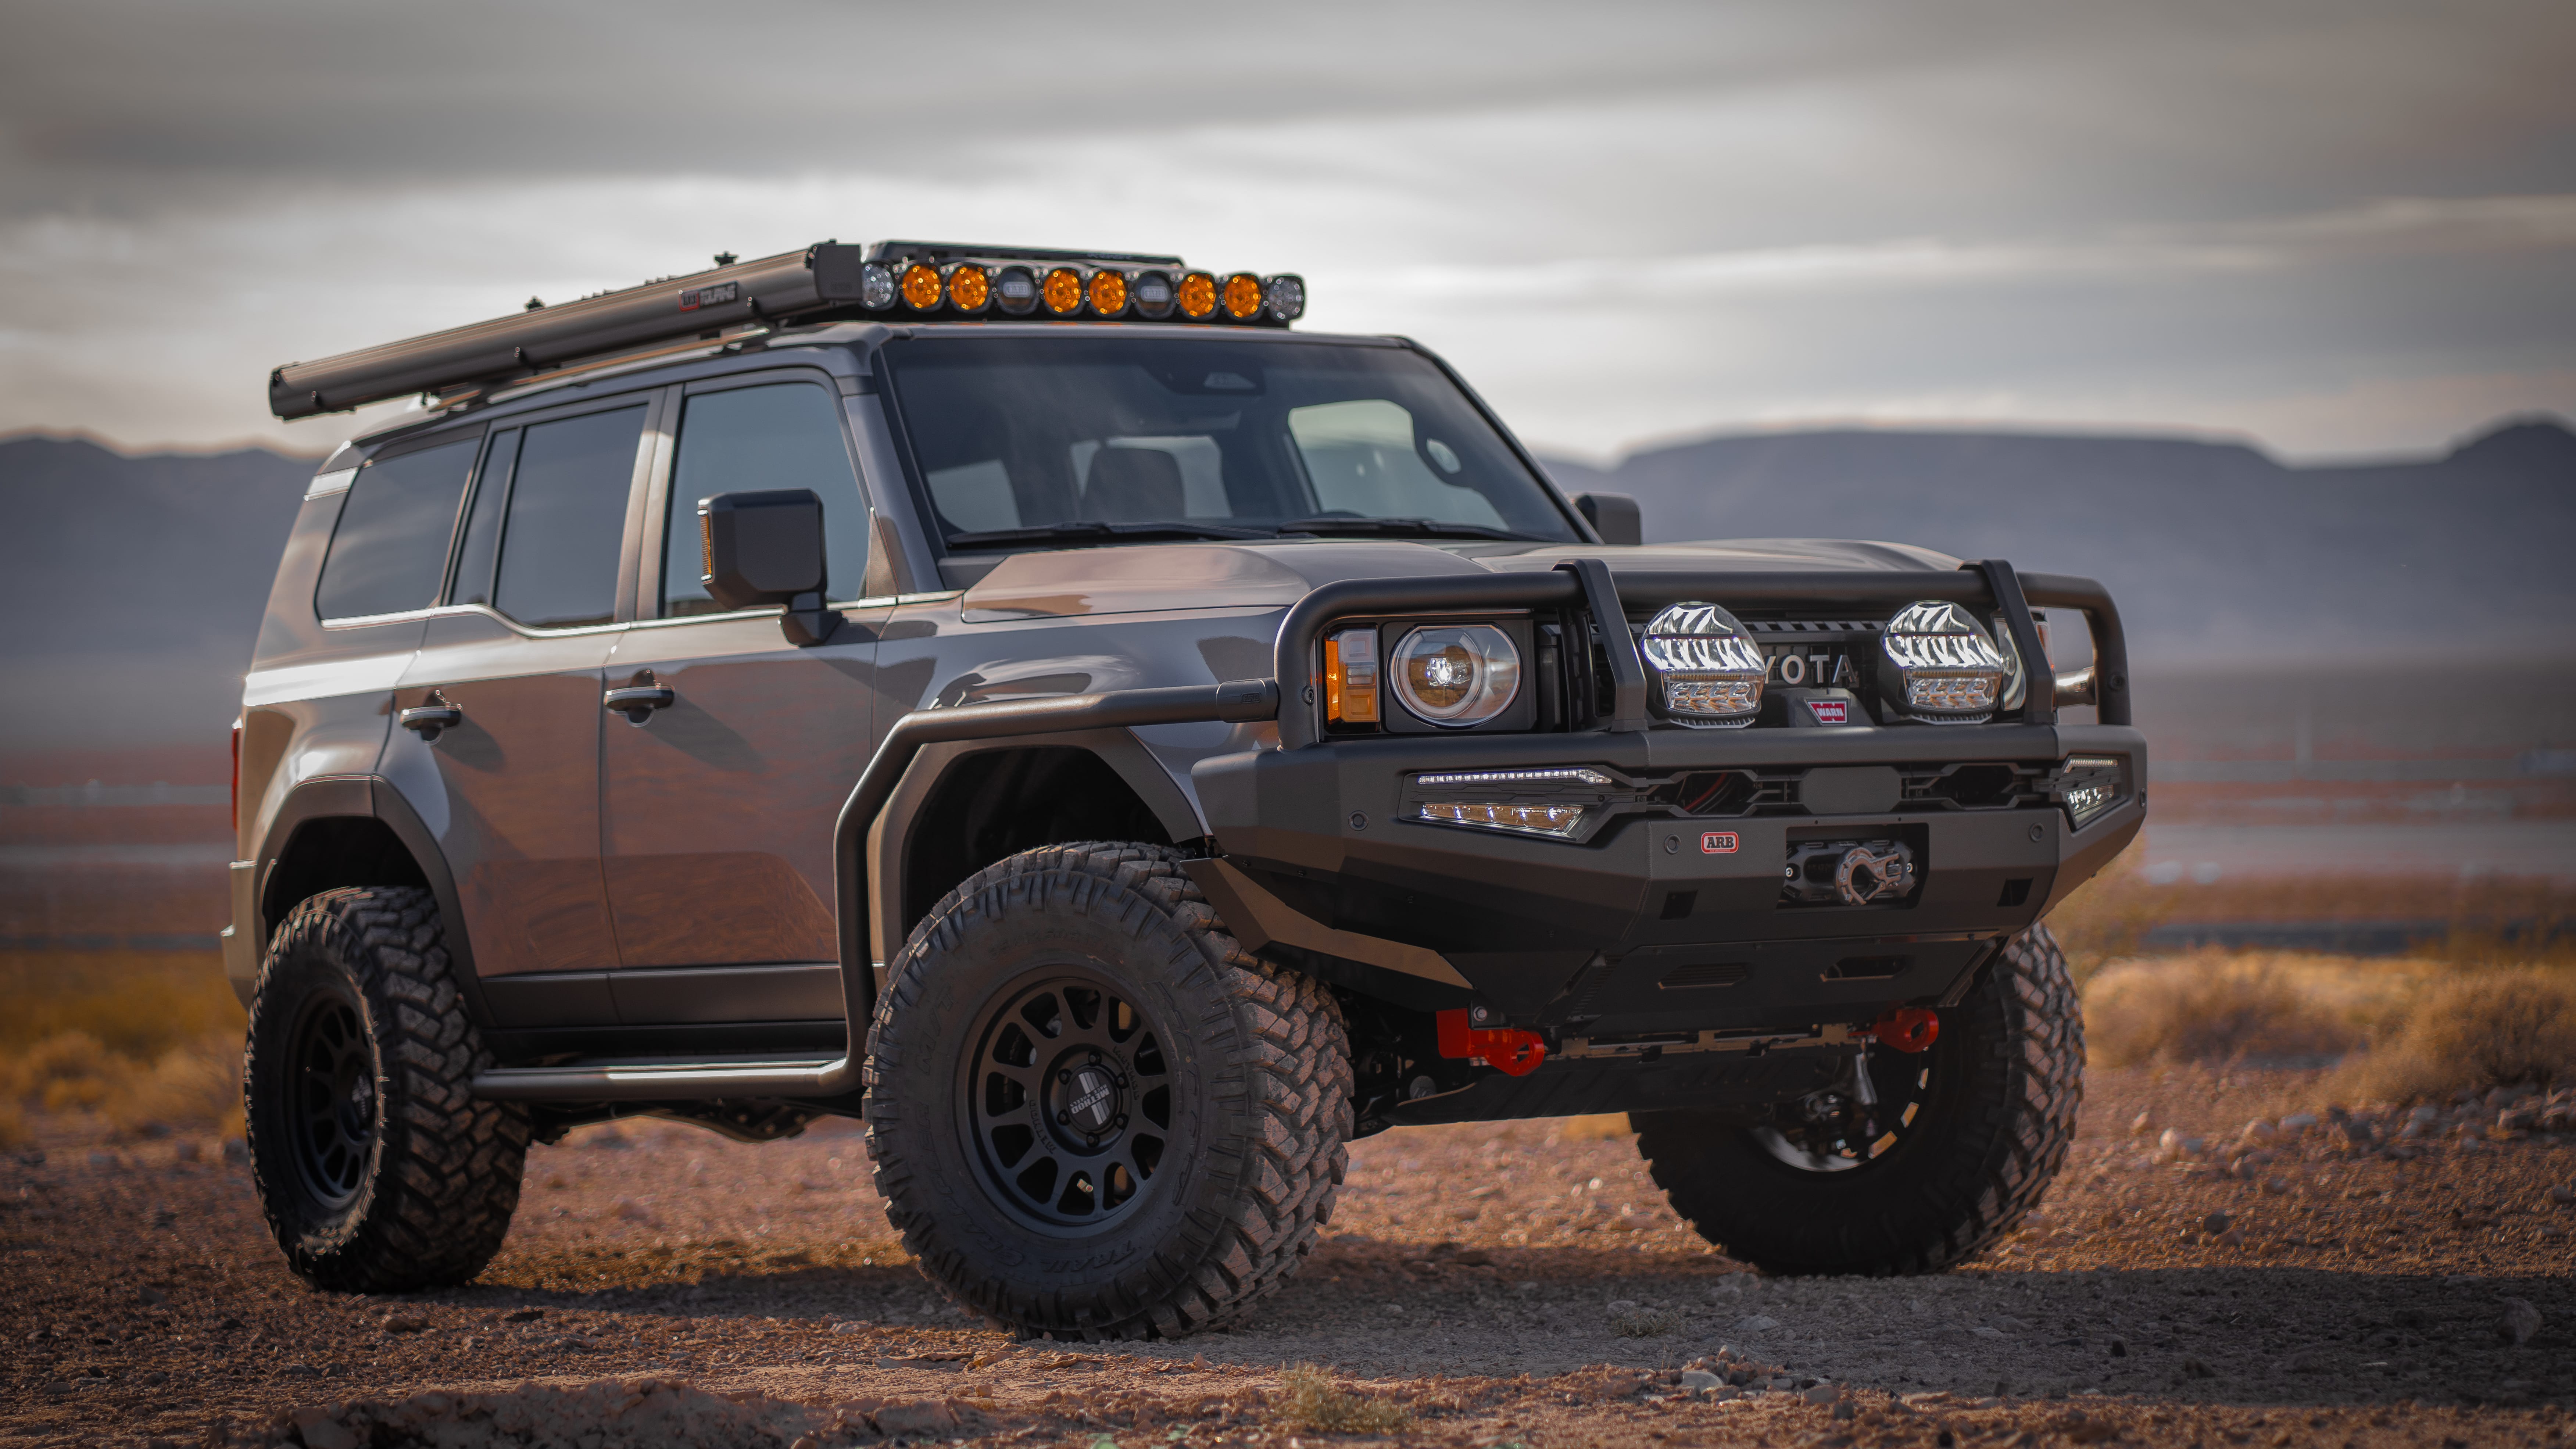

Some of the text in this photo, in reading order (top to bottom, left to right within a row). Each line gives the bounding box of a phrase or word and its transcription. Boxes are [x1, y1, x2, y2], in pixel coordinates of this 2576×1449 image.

[1765, 654, 1856, 684] YOTA
[1817, 708, 1844, 717] WARN
[1707, 837, 1734, 848] ARB
[1093, 1084, 1108, 1093] RACE
[1070, 1088, 1110, 1114] METHOD
